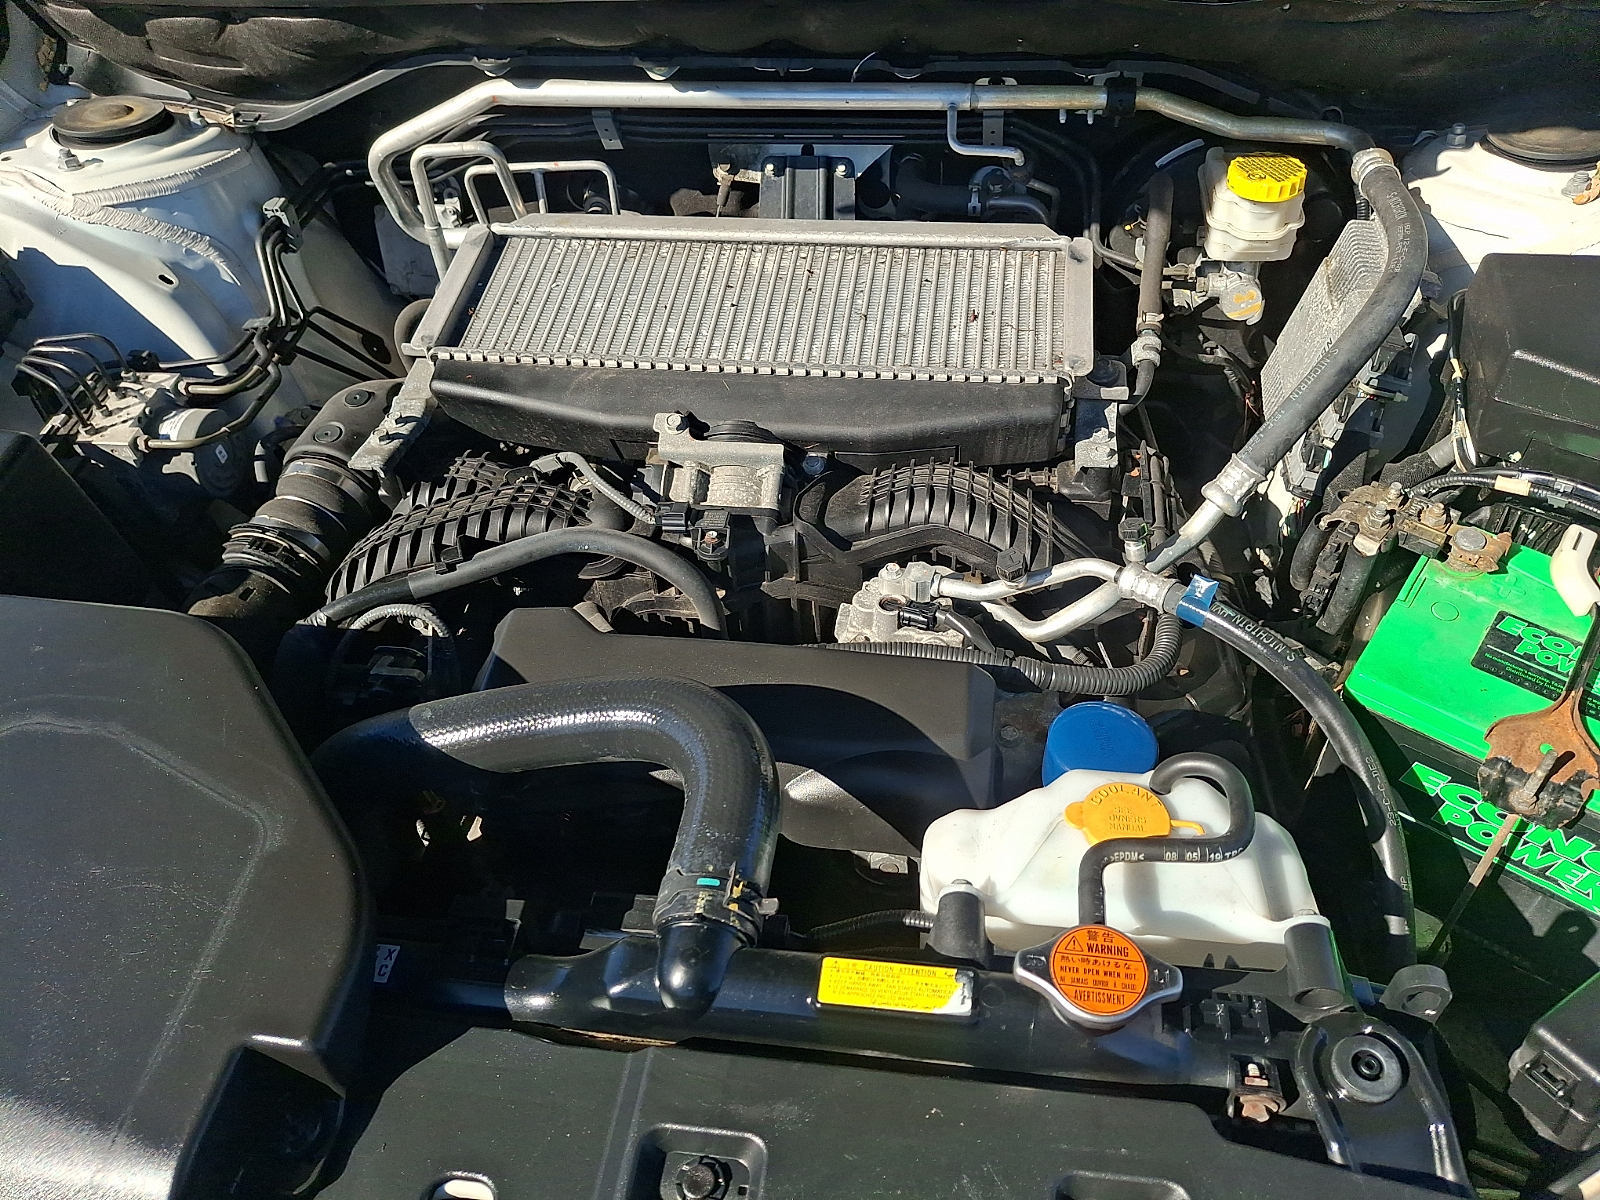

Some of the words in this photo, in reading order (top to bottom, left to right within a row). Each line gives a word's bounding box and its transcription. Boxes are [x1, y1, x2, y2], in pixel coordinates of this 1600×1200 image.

[1090, 784, 1162, 808] COOLANT
[1086, 942, 1129, 957] WARNING
[863, 963, 894, 973] CAUTION
[899, 967, 937, 977] ATTENTION
[1060, 965, 1079, 974] NEVER
[1083, 967, 1099, 976] OPEN
[1103, 969, 1121, 978] WHEN
[1070, 976, 1088, 985] JAMAIS
[1074, 989, 1125, 1005] AVERTISSMENT
